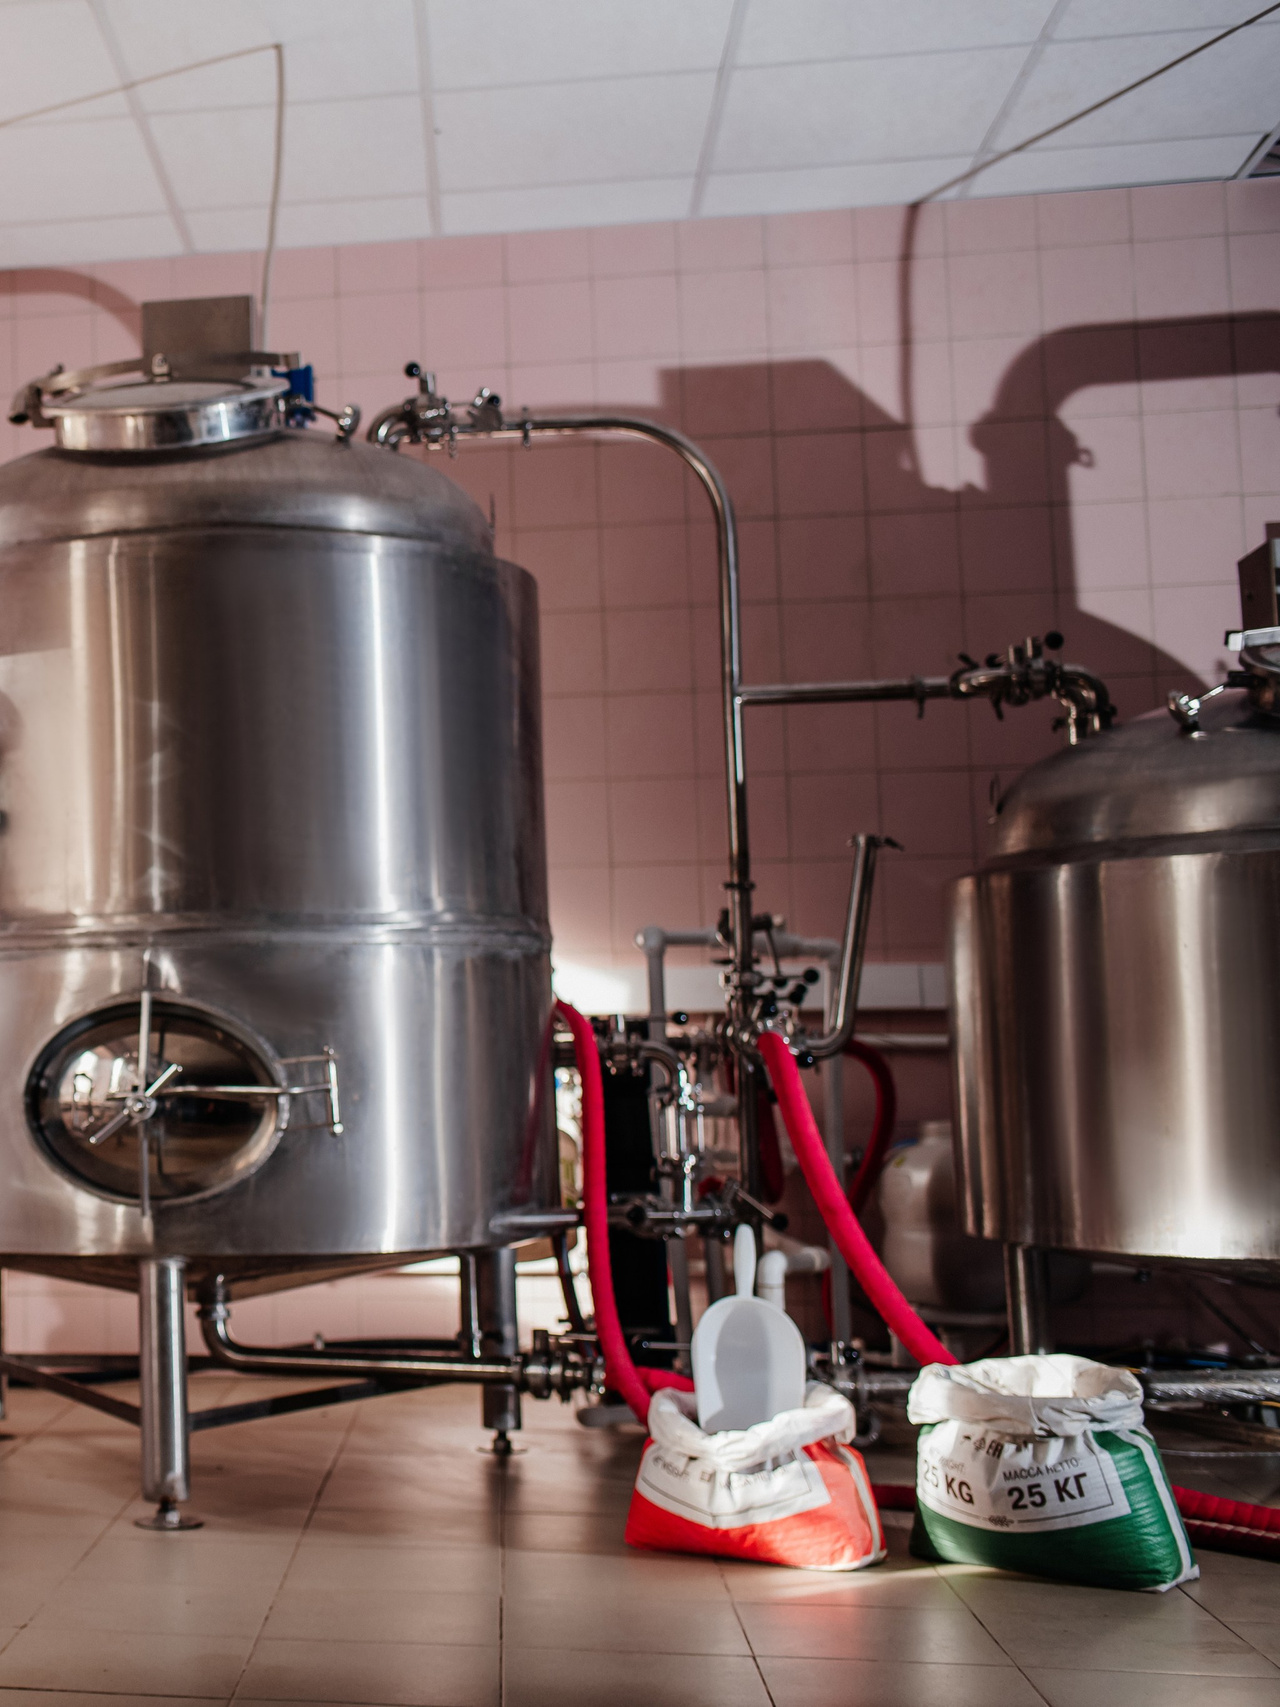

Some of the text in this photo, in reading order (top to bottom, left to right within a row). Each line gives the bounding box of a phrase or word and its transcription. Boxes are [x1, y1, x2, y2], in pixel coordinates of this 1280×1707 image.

[923, 1459, 974, 1505] 25 KG
[1003, 1466, 1043, 1481] МАССА
[1007, 1473, 1088, 1510] 25 КГ
